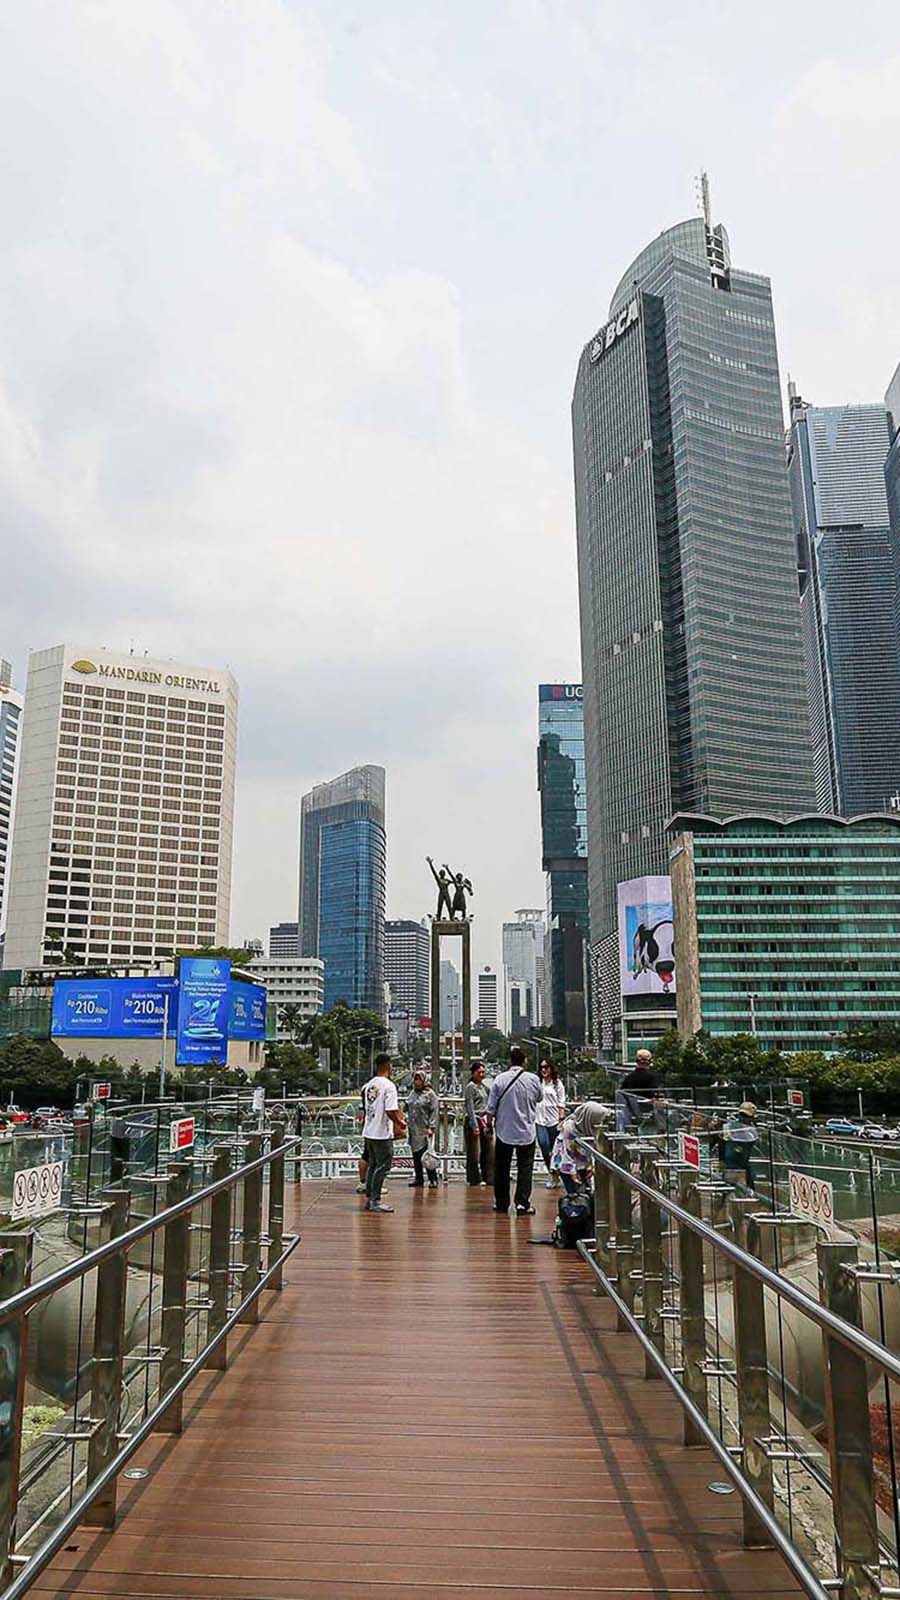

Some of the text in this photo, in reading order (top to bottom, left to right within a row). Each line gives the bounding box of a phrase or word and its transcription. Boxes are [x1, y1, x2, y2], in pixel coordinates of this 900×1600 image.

[604, 299, 639, 349] BCA
[99, 665, 220, 693] MANDARIN ORIENTAL
[75, 1001, 96, 1015] 210
[133, 1000, 156, 1015] 210
